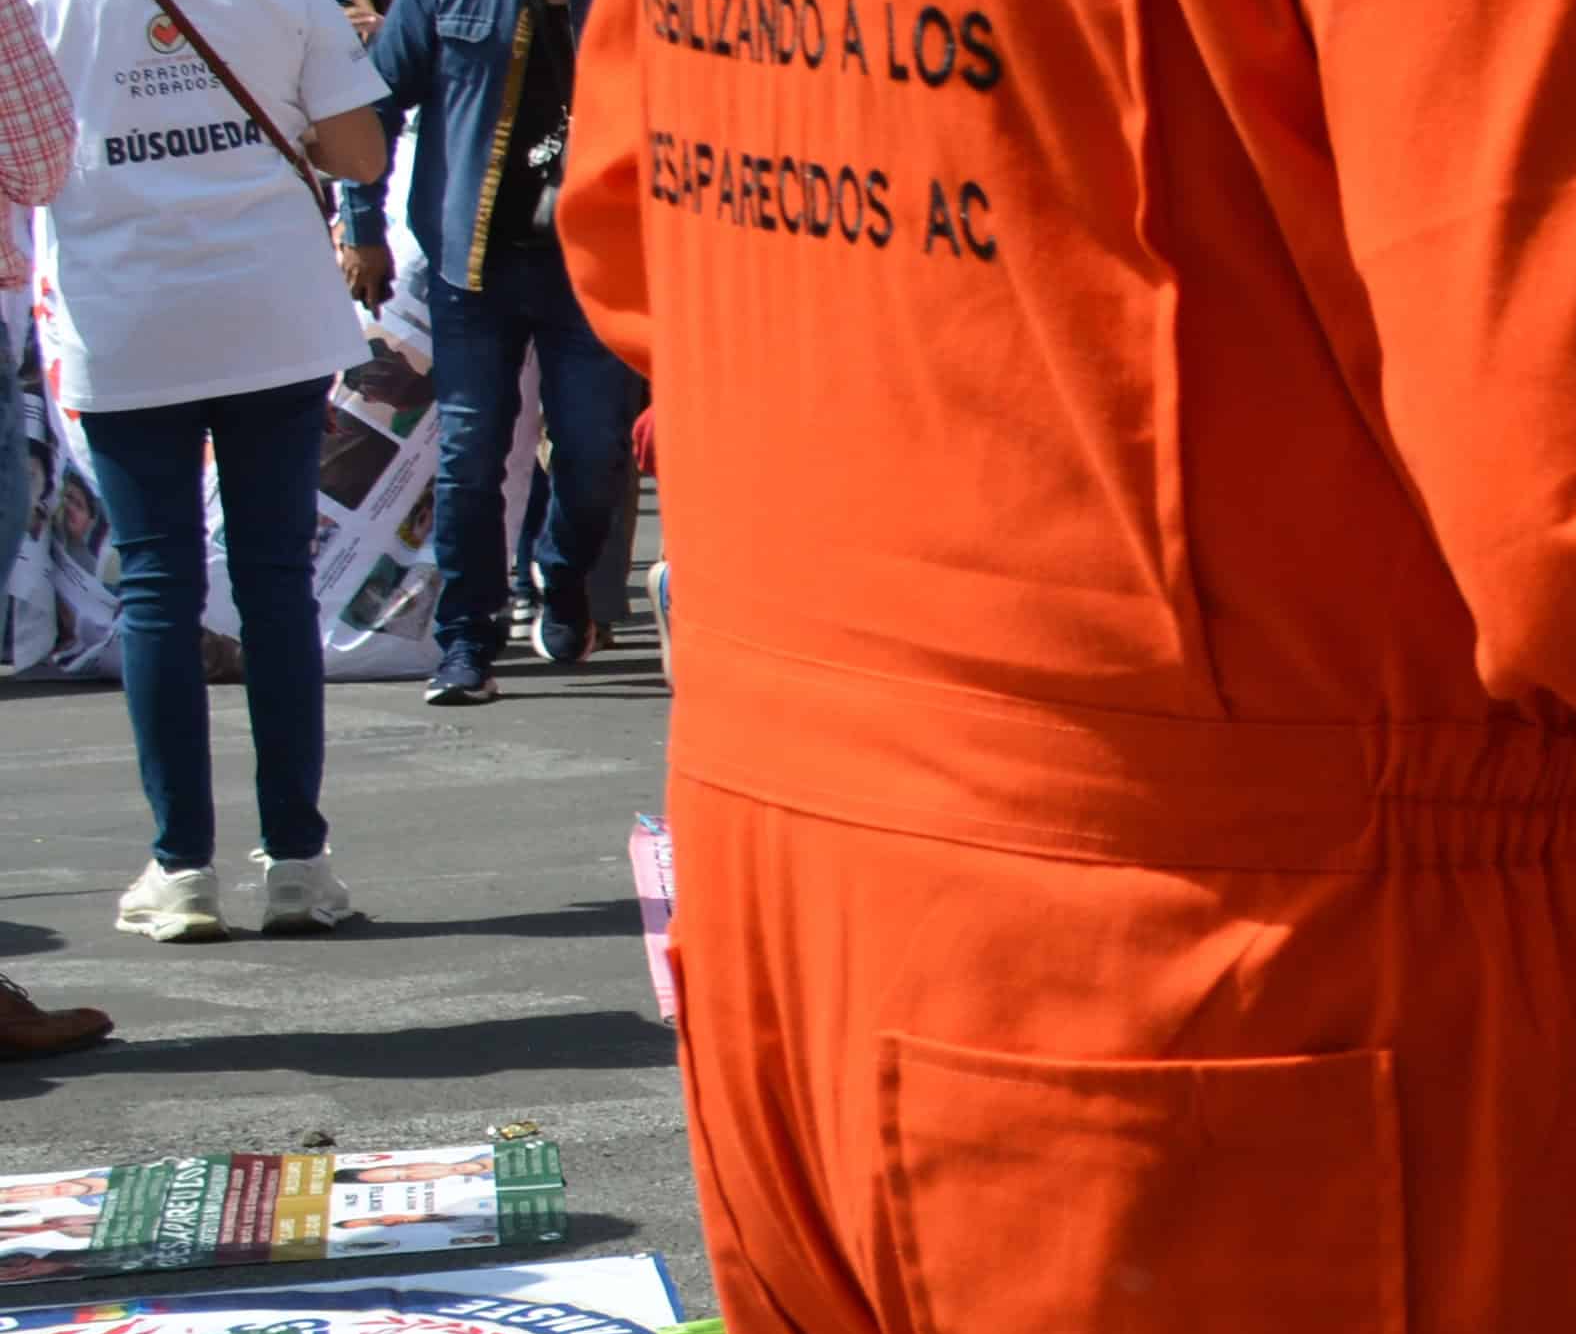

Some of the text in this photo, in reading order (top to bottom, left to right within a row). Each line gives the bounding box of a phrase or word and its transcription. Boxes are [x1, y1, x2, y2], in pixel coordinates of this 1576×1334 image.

[885, 3, 1001, 92] LOS
[115, 61, 212, 85] CORAZON
[131, 77, 220, 98] ROBADOS
[105, 119, 262, 166] BÚSQUEDA
[924, 178, 997, 262] AC
